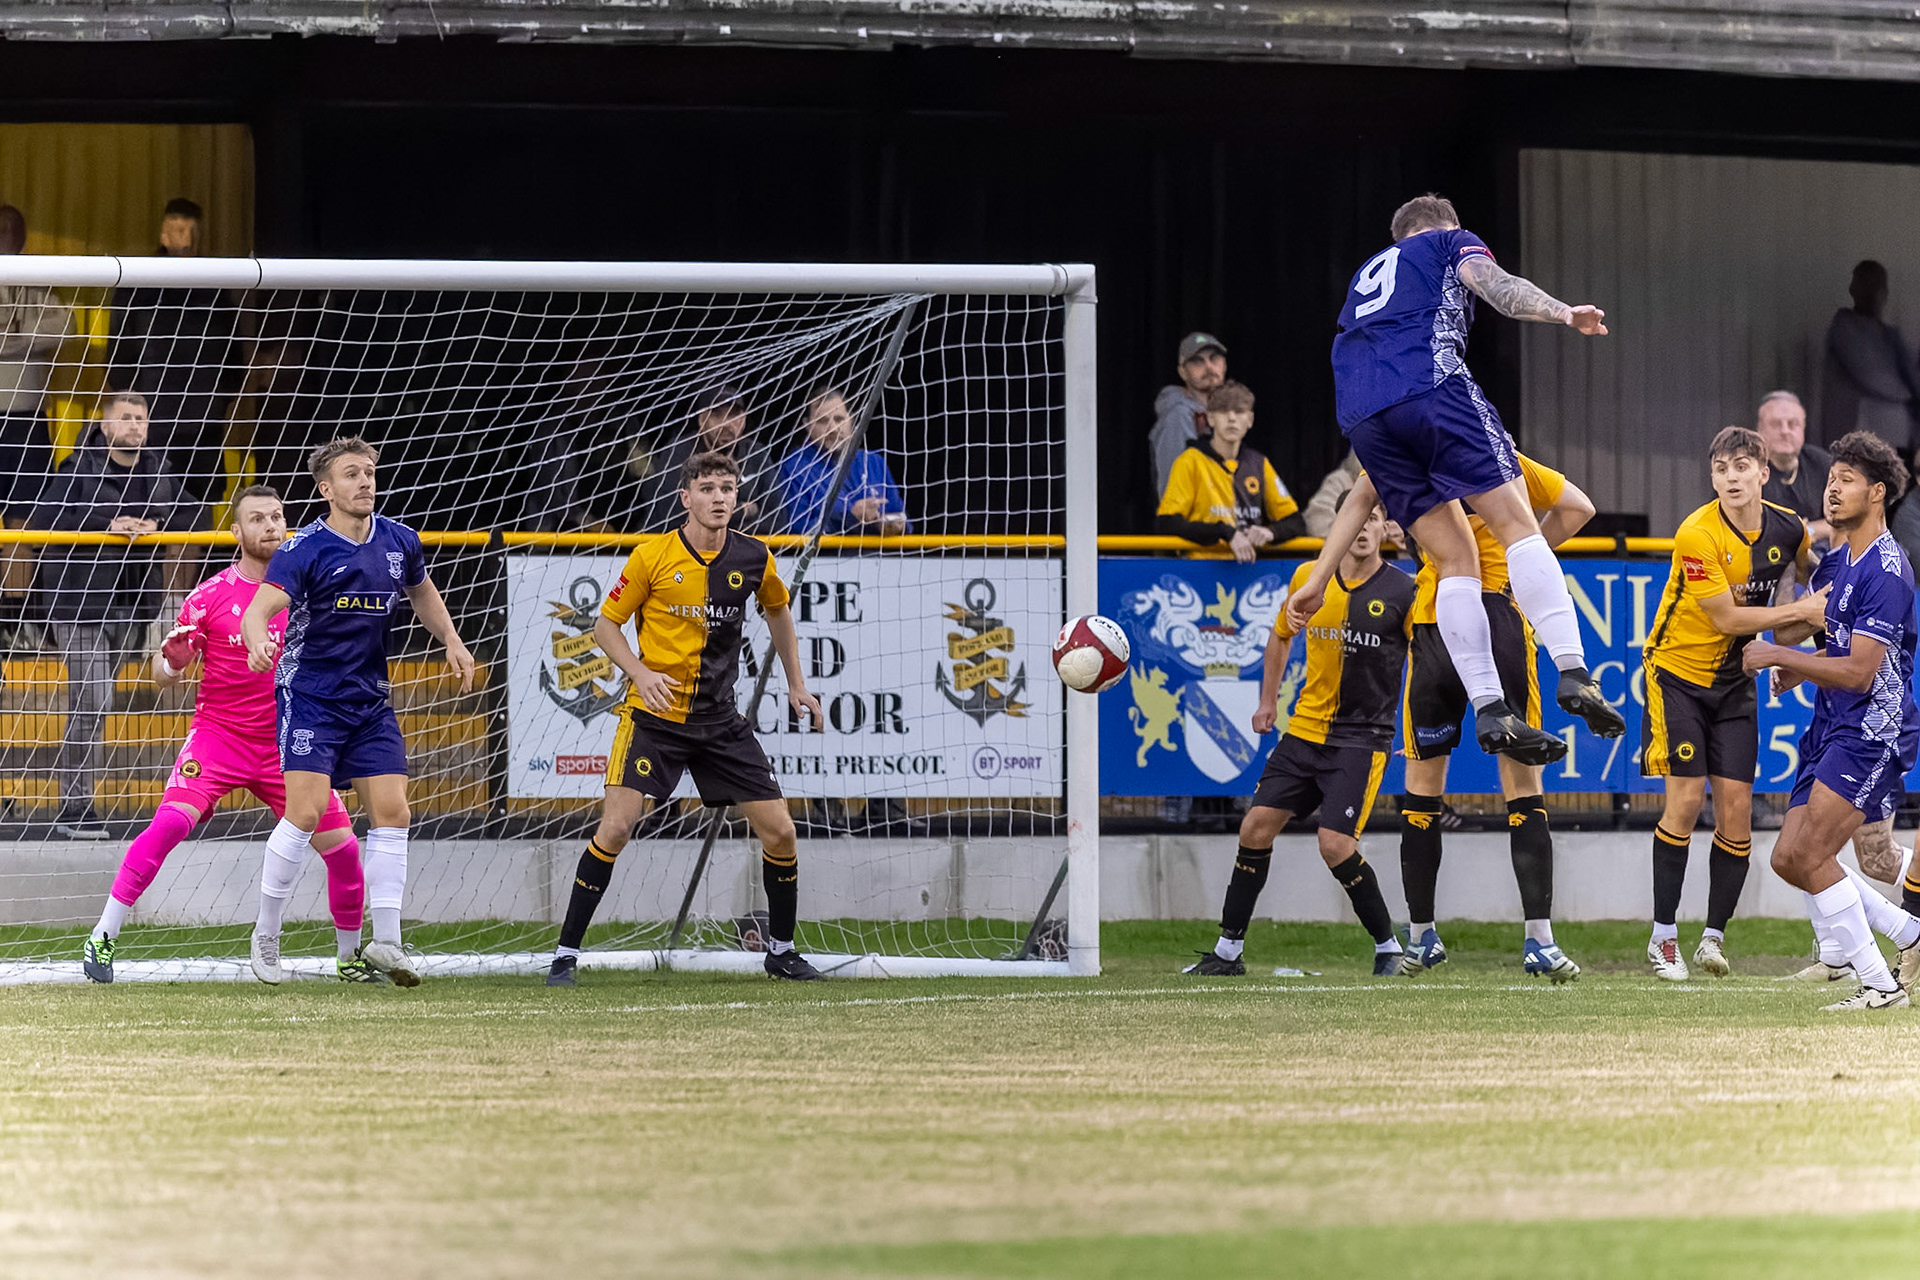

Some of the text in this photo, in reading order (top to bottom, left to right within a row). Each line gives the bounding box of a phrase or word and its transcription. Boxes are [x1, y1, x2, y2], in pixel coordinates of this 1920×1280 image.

[1354, 246, 1401, 320] 9
[336, 596, 386, 611] BALL
[668, 603, 740, 619] MERMAID
[1309, 626, 1381, 648] MERMAID
[751, 691, 910, 735] CHOR
[528, 757, 551, 774] sky
[558, 757, 606, 774] sports
[768, 755, 946, 777] REET, PRESCOT.
[979, 756, 1042, 770] BT SPORT
